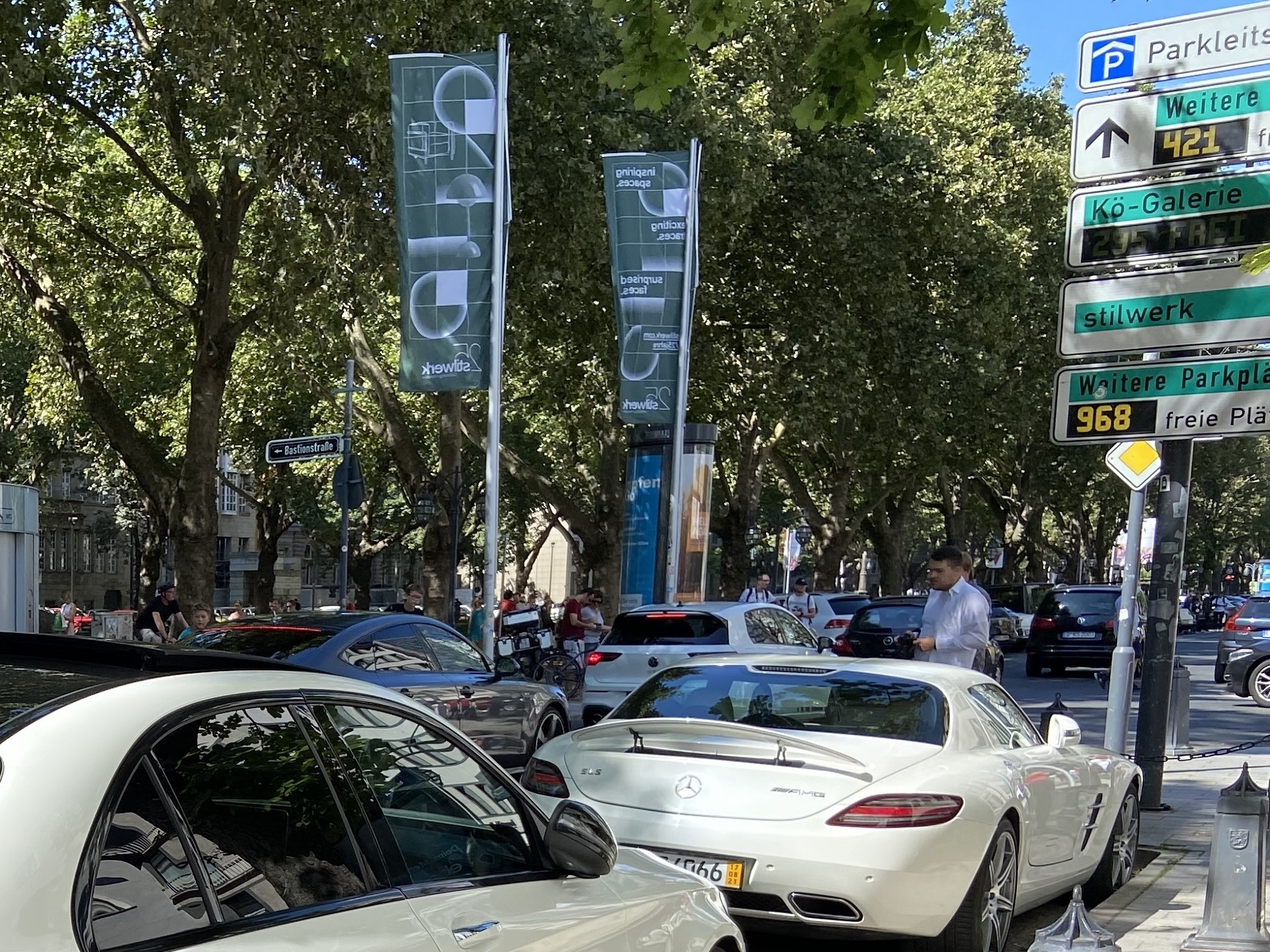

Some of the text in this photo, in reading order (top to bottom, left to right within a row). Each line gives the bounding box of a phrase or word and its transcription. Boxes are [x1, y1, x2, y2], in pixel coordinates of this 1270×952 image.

[1166, 90, 1259, 119] Weitere
[1163, 125, 1220, 158] 421
[1092, 184, 1242, 220] Kö-Galerie
[1083, 298, 1194, 328] stilwerk
[1079, 374, 1167, 396] Weitere
[1076, 404, 1132, 433] 968
[1165, 406, 1270, 430] freie Plä
[284, 441, 334, 455] Bastionstraße
